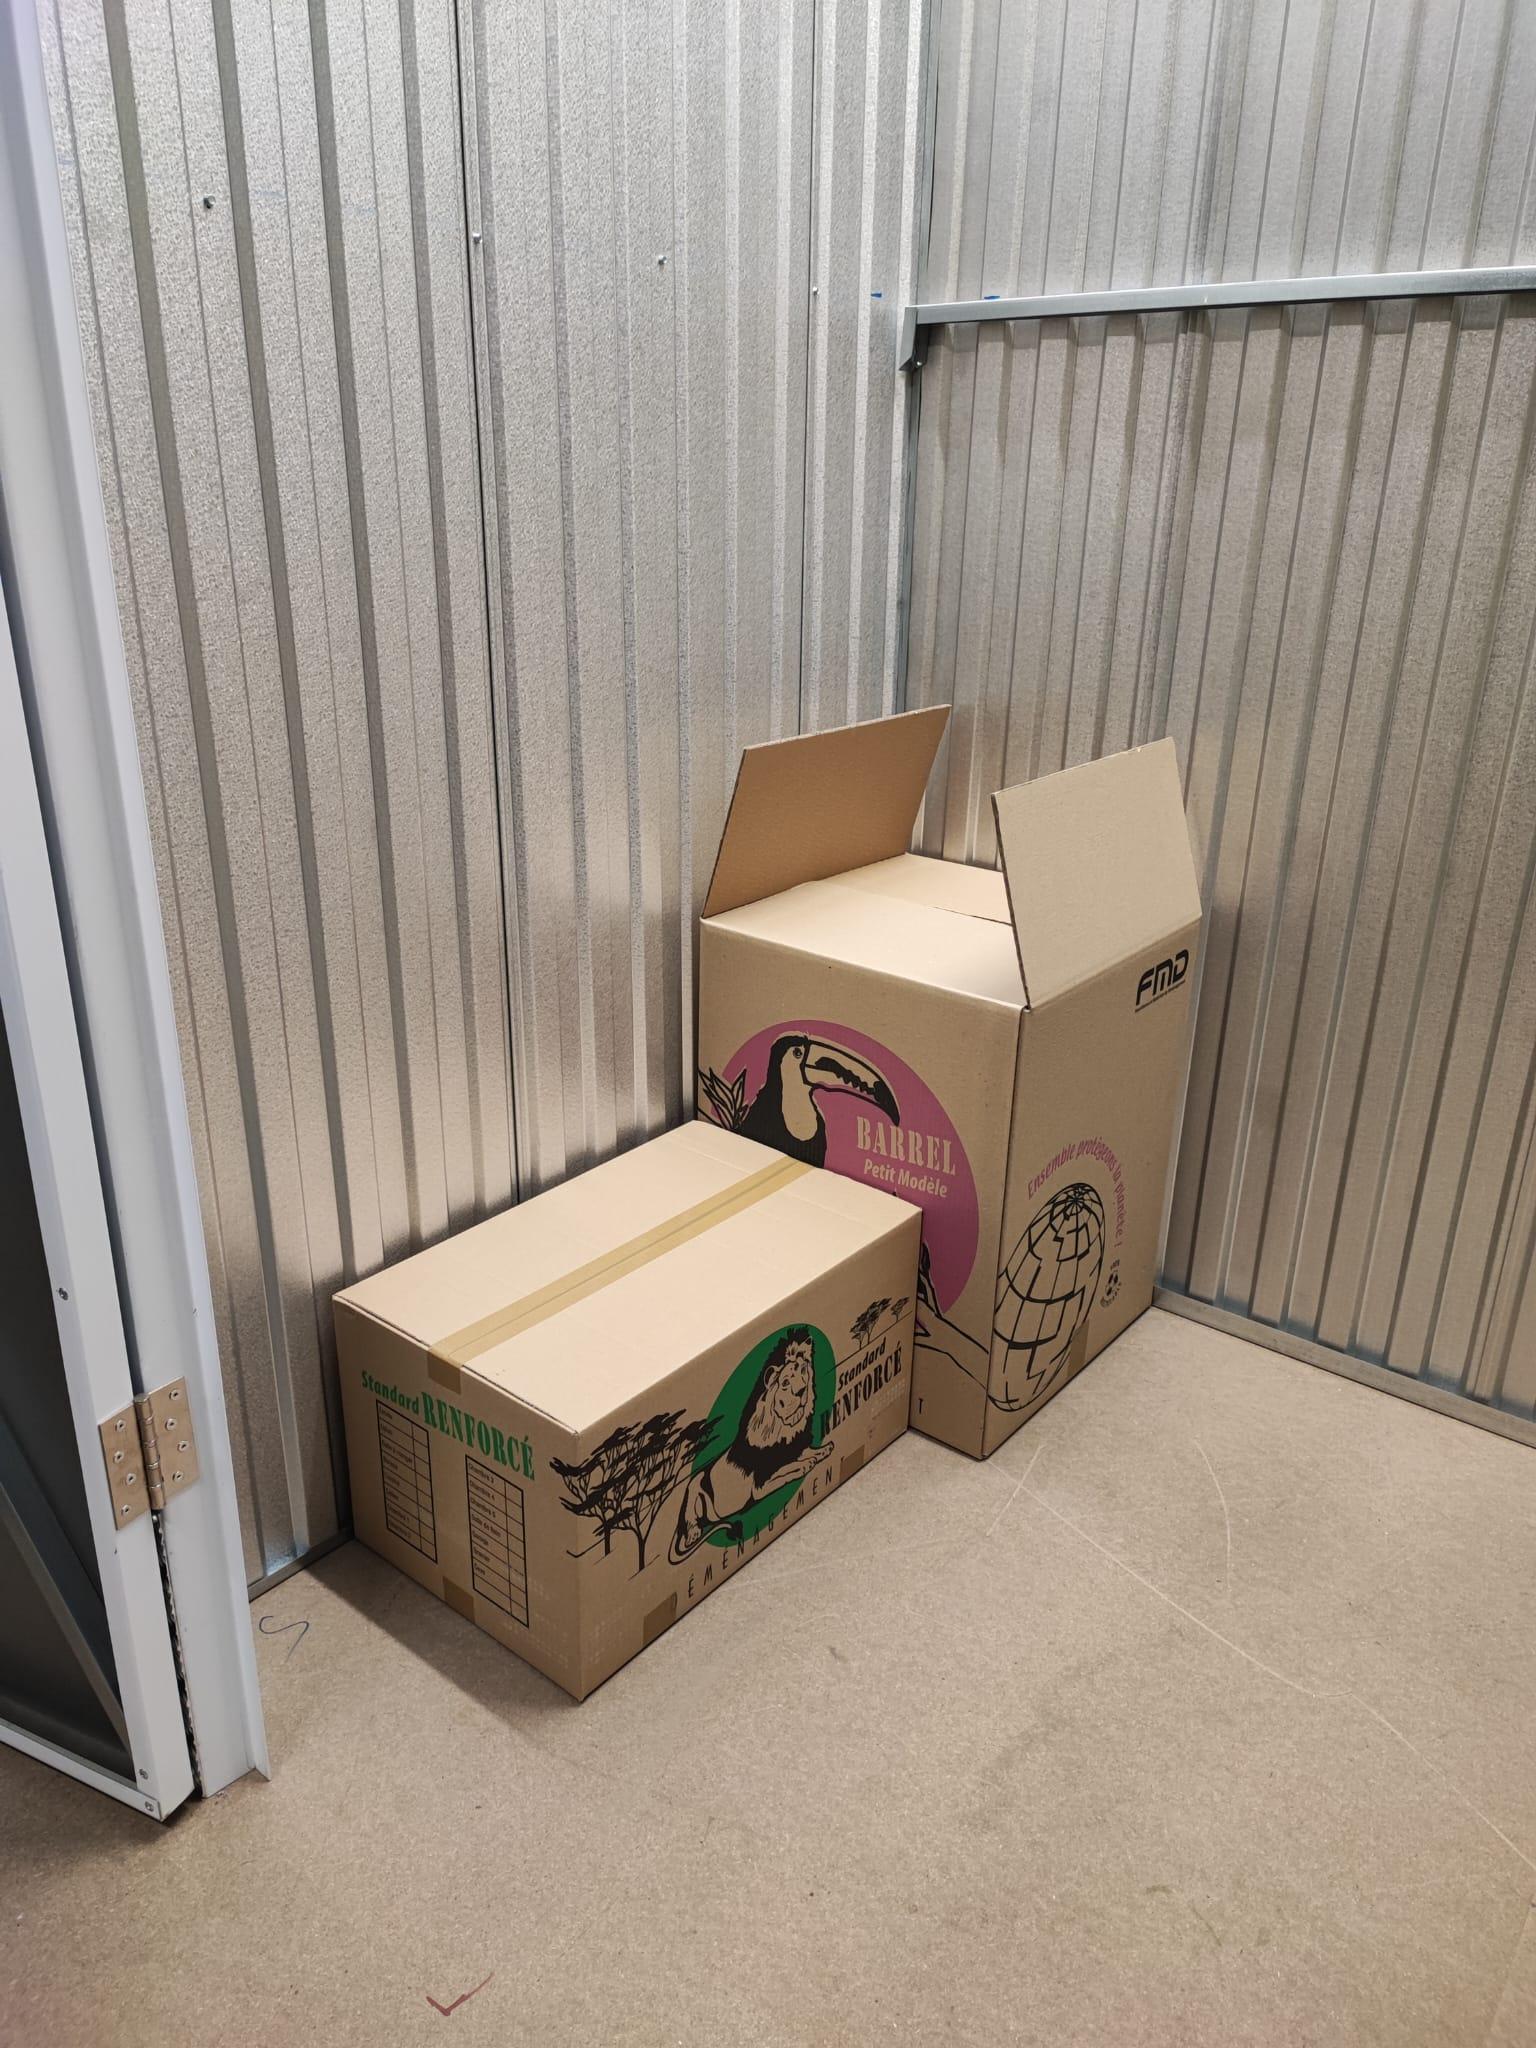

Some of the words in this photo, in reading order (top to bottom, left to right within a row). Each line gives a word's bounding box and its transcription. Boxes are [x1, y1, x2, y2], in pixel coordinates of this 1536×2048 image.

[1135, 948, 1190, 1006] FMD
[856, 1115, 956, 1177] BARREL
[1027, 1143, 1076, 1201] Ensemble
[863, 1157, 897, 1183] Petit
[897, 1168, 948, 1198] Modèle
[820, 1340, 902, 1441] RENFORCÉ
[837, 1335, 887, 1392] Standard
[361, 1369, 420, 1416] Standard
[421, 1391, 535, 1481] RENFORCÉ
